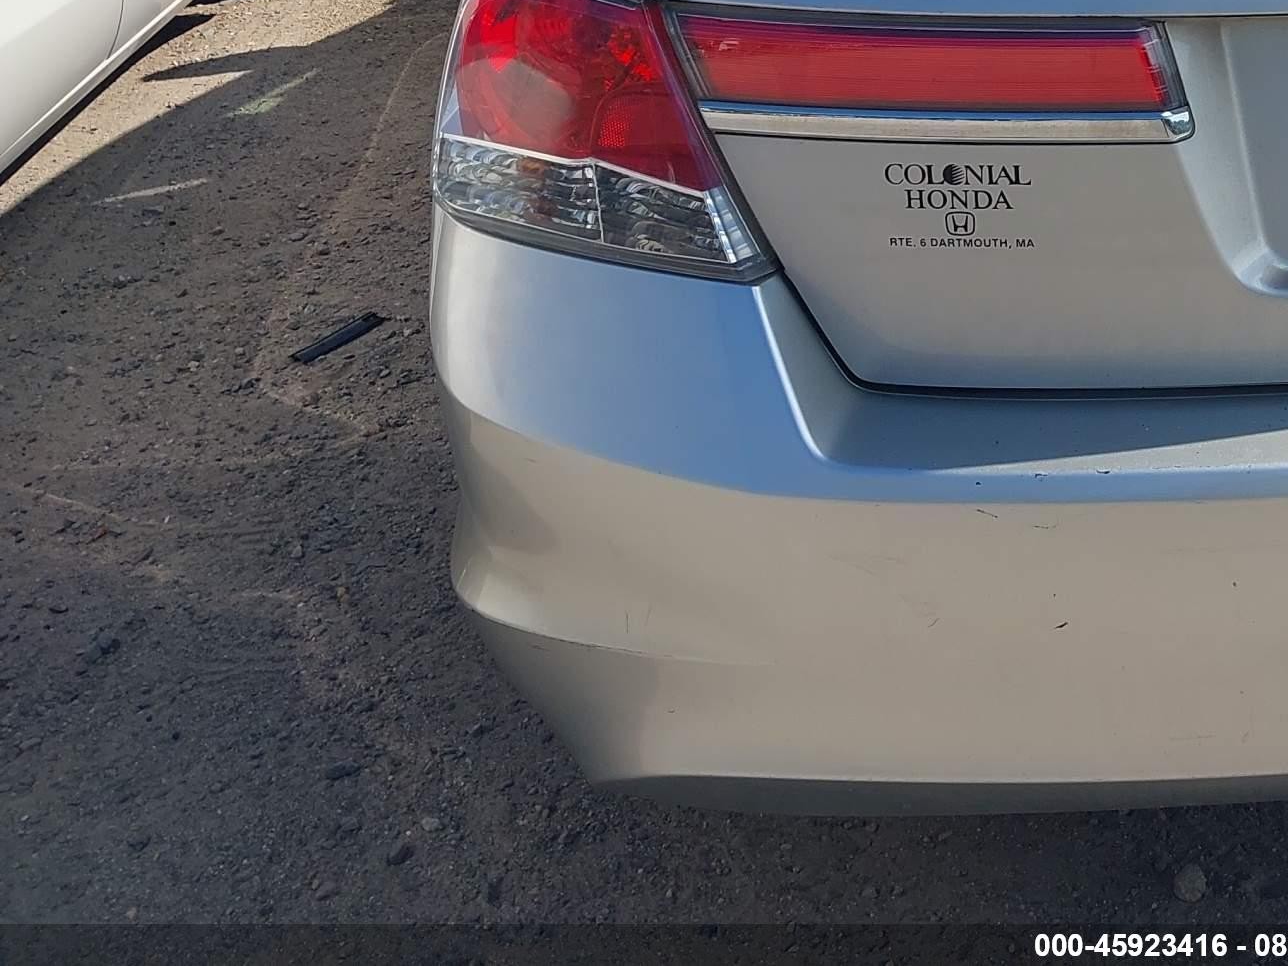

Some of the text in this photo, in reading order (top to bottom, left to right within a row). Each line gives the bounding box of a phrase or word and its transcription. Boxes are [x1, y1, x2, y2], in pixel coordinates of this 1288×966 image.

[884, 163, 1032, 186] COLONIAL
[904, 189, 1014, 210] HONDA
[889, 237, 1035, 249] RTE. 6 DARTMOUTH, MA
